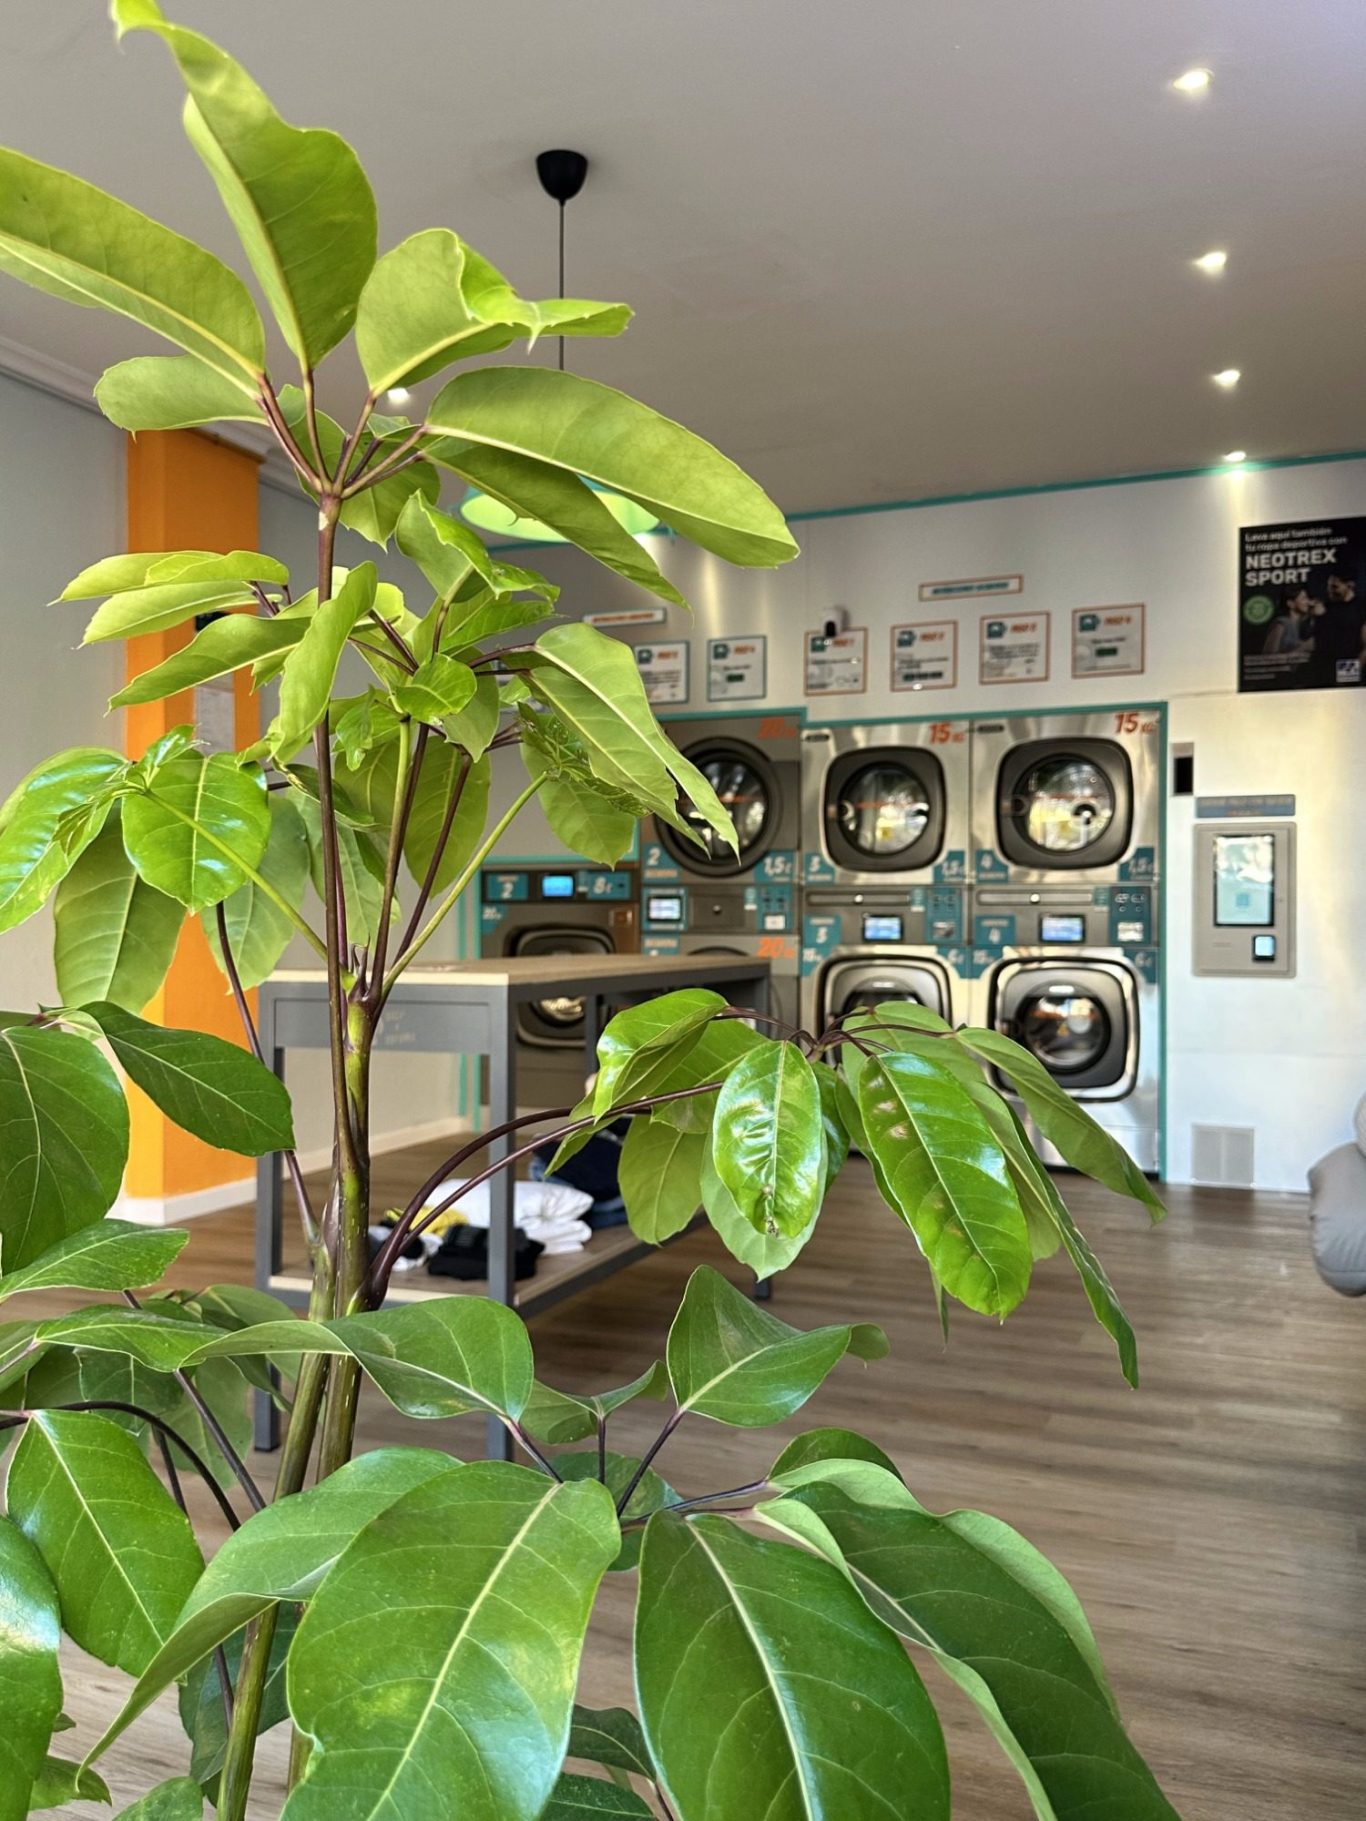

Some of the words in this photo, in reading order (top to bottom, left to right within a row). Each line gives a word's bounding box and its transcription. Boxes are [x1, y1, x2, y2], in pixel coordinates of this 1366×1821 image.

[1245, 548, 1337, 570] NEOTREX
[1245, 567, 1311, 587] SPORT
[928, 721, 951, 744] 15
[1115, 712, 1138, 734] 15
[647, 847, 661, 866] 2
[501, 882, 514, 899] 2
[756, 935, 784, 959] 20
